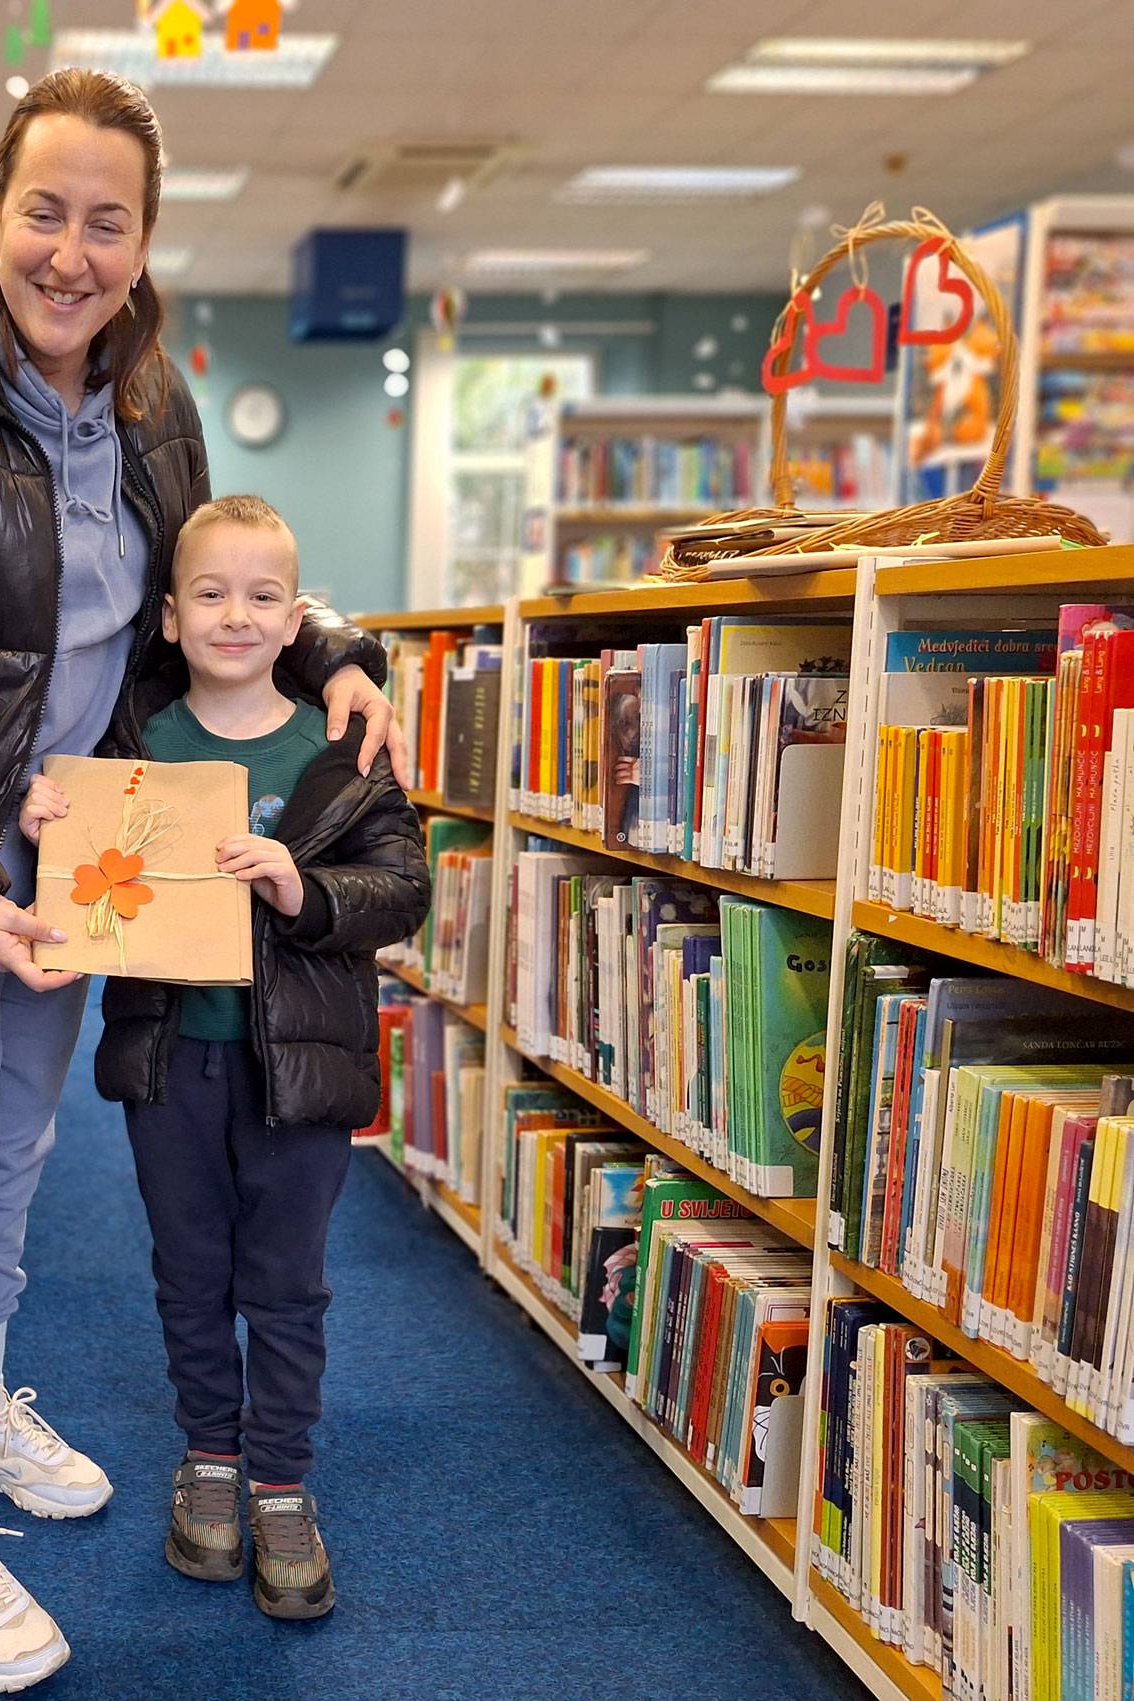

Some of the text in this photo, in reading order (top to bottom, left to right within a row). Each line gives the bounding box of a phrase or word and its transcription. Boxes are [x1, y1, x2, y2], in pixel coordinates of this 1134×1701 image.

[918, 638, 990, 657] Medvjedići
[994, 639, 1030, 653] dobra
[1082, 675, 1091, 693] Lang
[1095, 675, 1103, 693] Lang
[835, 690, 847, 703] Z
[1023, 1039, 1054, 1049] SANDA
[660, 1199, 674, 1218] U
[1071, 1211, 1080, 1238] KASNO
[194, 1464, 237, 1474] SKECHERS
[258, 1497, 303, 1505] SKECHERS
